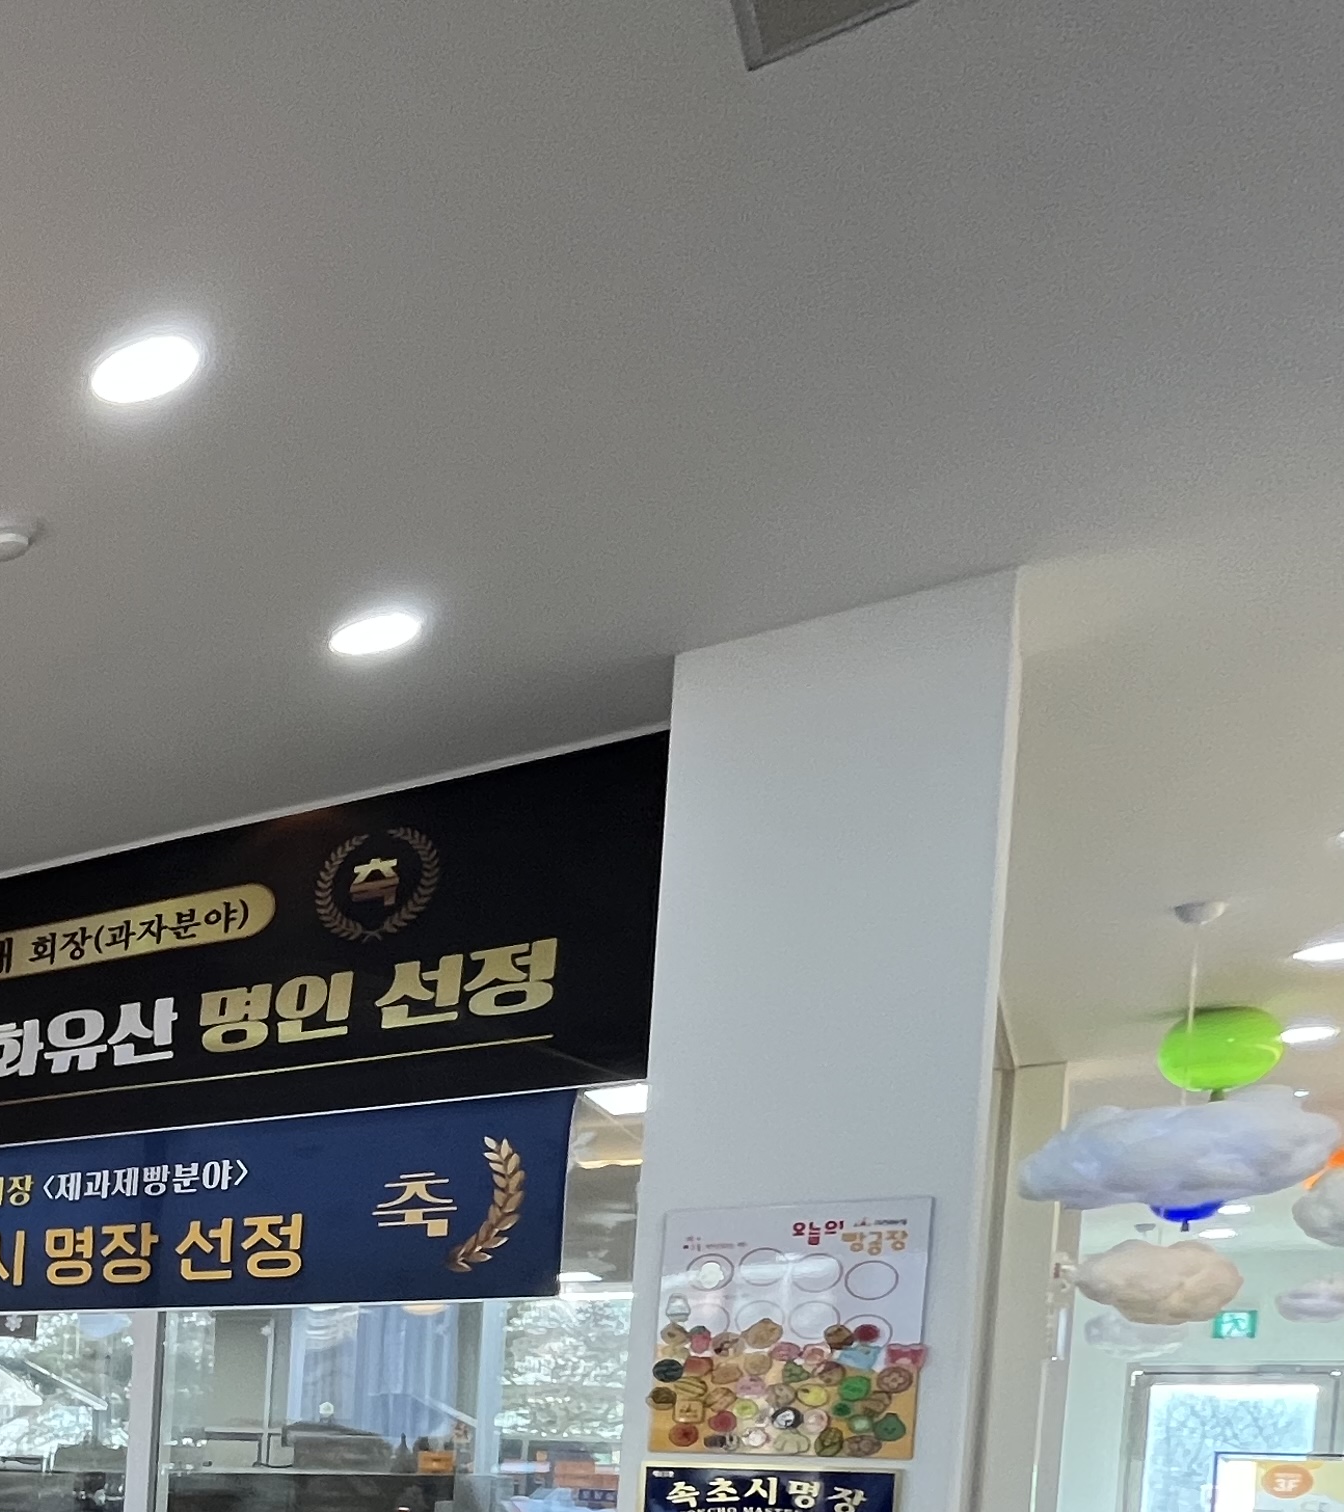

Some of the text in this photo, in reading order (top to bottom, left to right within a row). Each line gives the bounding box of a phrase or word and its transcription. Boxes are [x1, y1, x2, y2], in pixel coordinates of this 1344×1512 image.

[348, 857, 400, 907] 축
[28, 898, 250, 963] 회장(과자분야)
[198, 970, 356, 1053] 명인
[375, 938, 559, 1030] 선정
[371, 1169, 459, 1238] 축
[792, 1220, 844, 1246] 오늘의
[44, 1221, 160, 1287] 명장
[174, 1212, 305, 1283] 선정
[1273, 1479, 1298, 1492] 3F
